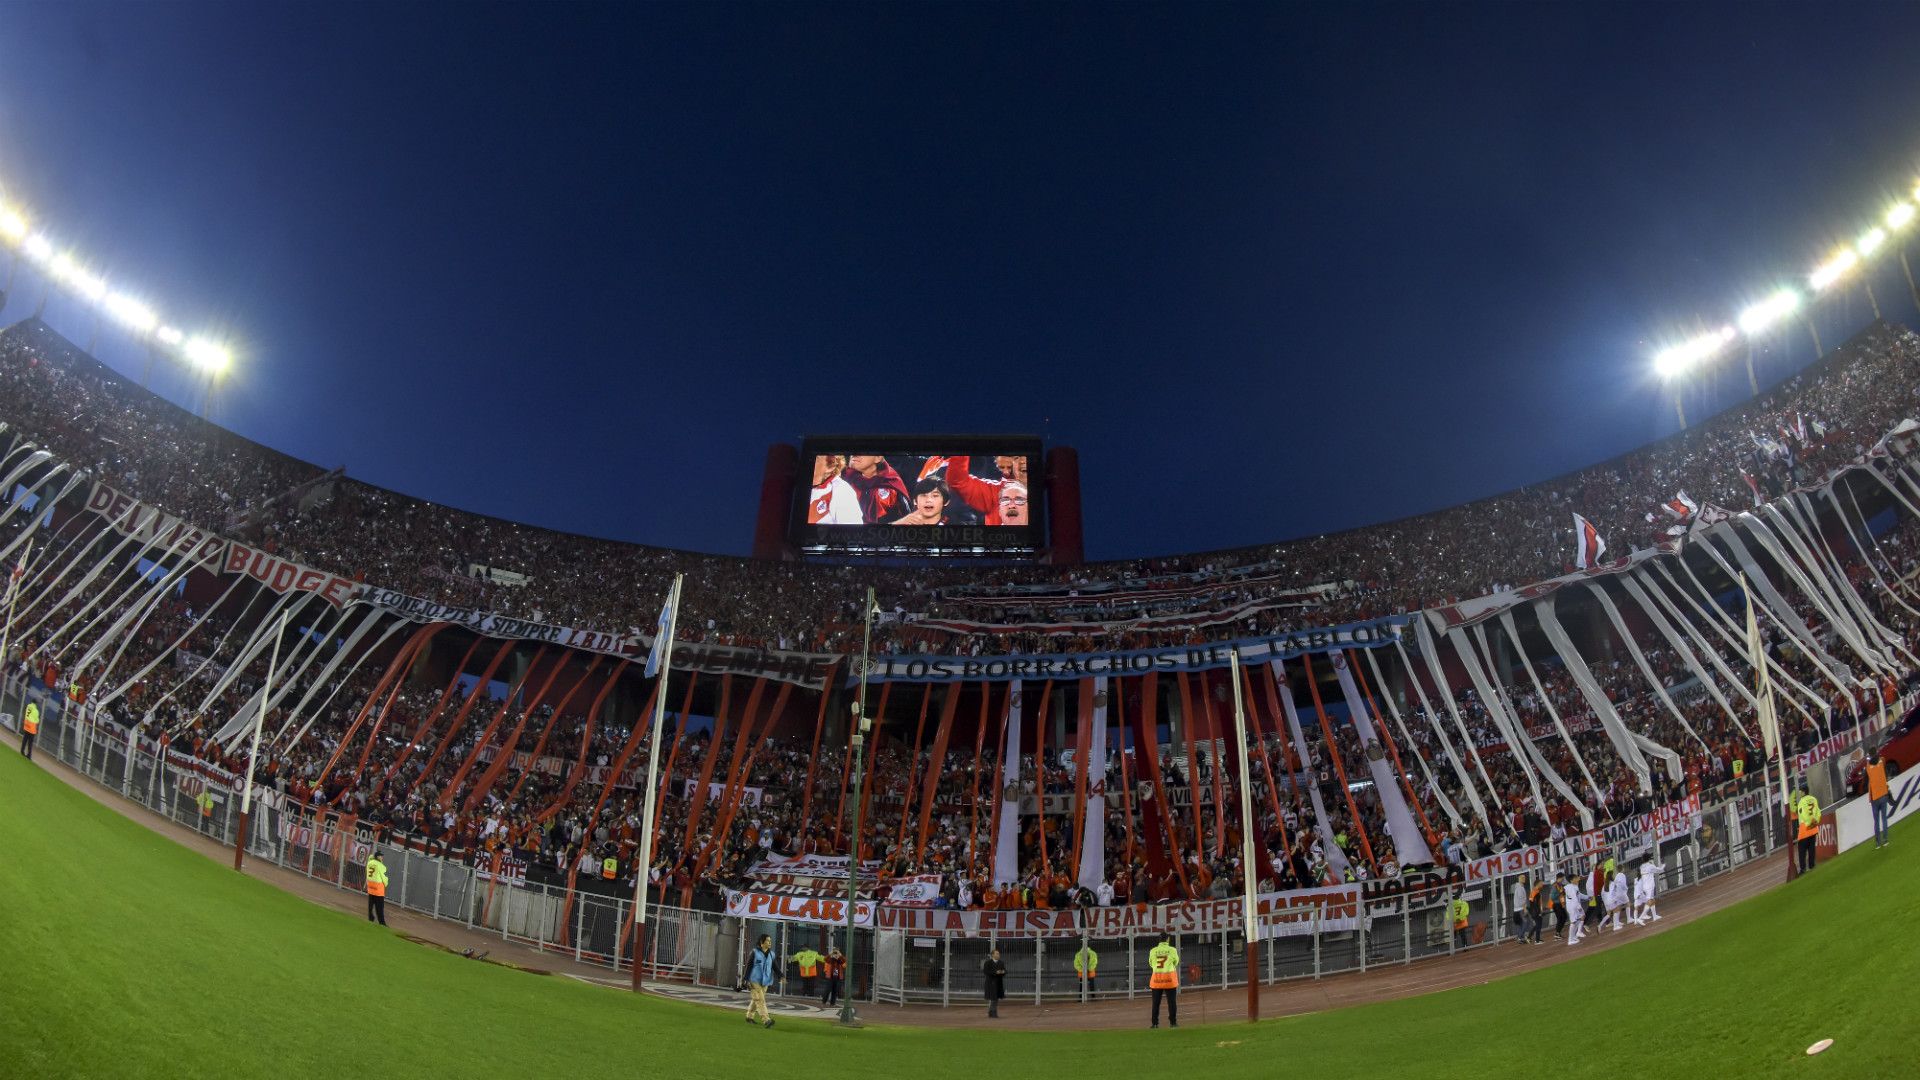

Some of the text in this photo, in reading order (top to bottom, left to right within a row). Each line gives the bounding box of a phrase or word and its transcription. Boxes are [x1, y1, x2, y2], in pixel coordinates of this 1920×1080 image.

[226, 543, 353, 608] BUDGE
[489, 616, 562, 641] SIEMPRE
[885, 658, 955, 680] LOS
[962, 650, 1180, 678] BORRACHOS
[1604, 815, 1640, 845] MAYO
[748, 893, 844, 922] PILAR
[878, 909, 1077, 938] VILLA ELISA
